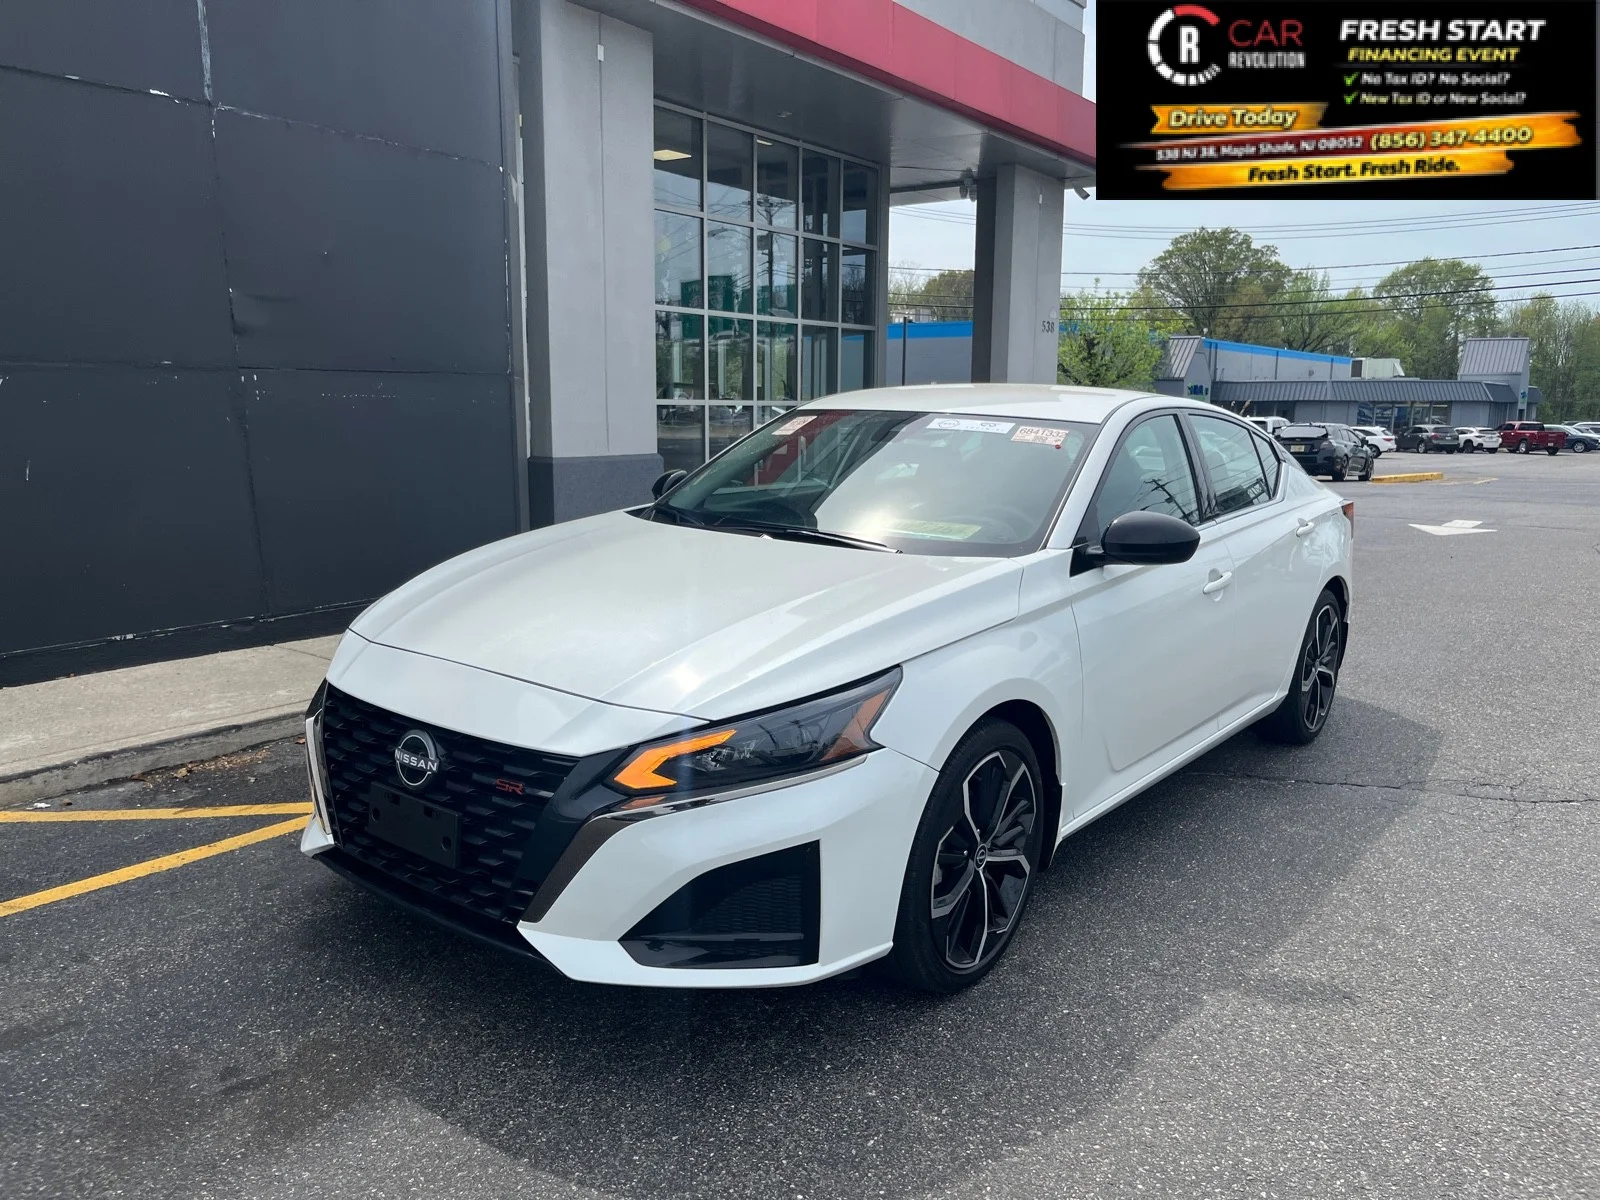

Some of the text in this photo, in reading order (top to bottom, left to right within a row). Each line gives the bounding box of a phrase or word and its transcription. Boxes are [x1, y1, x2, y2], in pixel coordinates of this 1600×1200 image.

[1041, 320, 1055, 333] 538
[394, 748, 438, 772] NISSAN
[495, 778, 524, 795] SR
